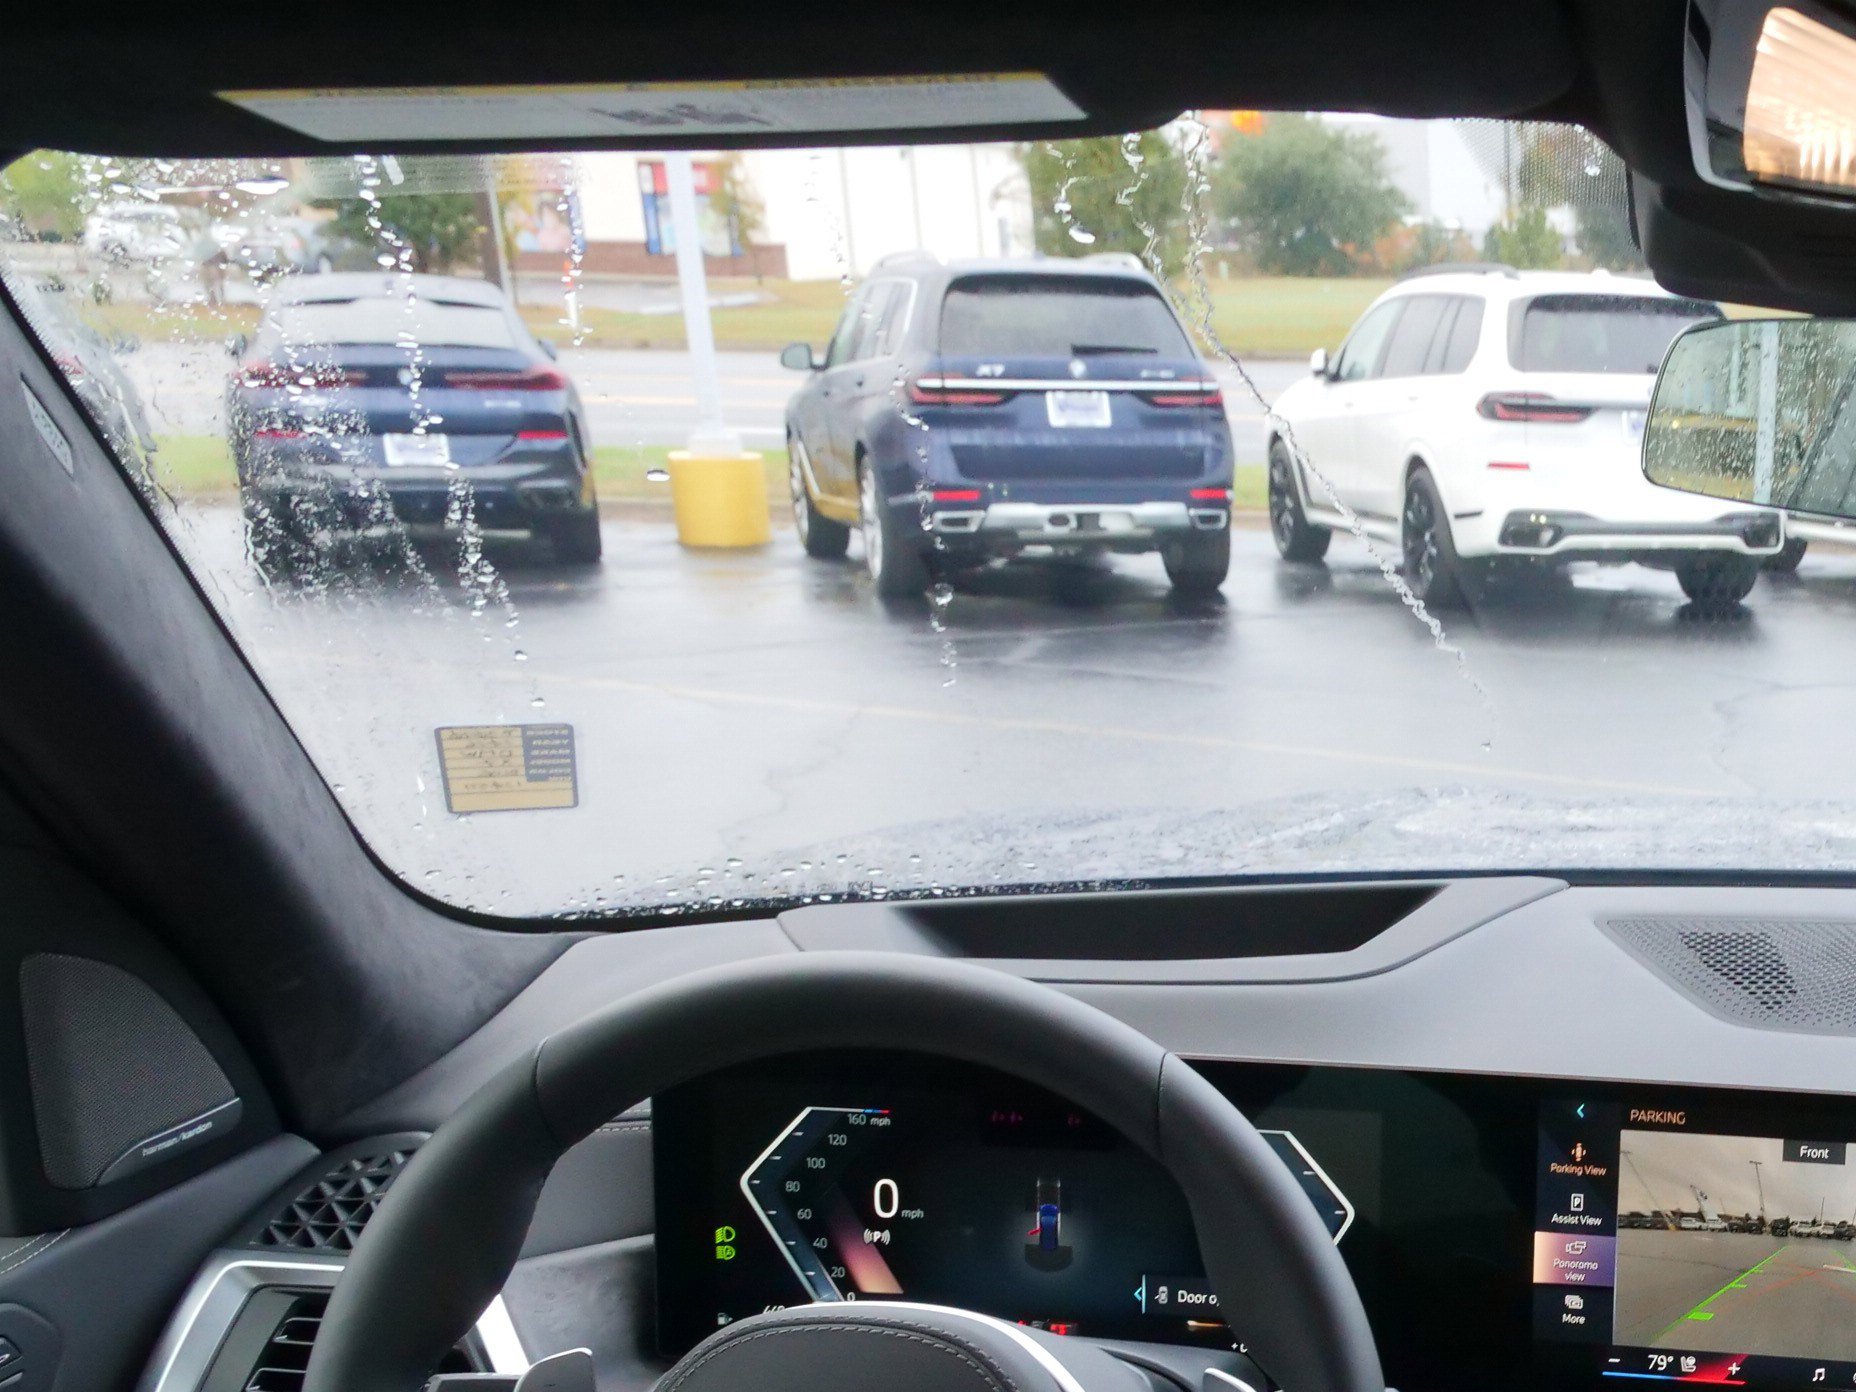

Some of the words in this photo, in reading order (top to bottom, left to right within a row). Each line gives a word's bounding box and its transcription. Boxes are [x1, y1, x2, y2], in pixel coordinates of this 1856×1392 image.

[848, 1113, 866, 1125] 160
[870, 1117, 890, 1126] mph
[1630, 1109, 1686, 1125] PARKING
[828, 1134, 847, 1146] 120
[1800, 1145, 1830, 1160] Front
[806, 1157, 826, 1169] 100
[1550, 1162, 1583, 1177] Parking
[1584, 1165, 1607, 1177] View
[785, 1180, 800, 1193] 80
[873, 1178, 899, 1219] 0
[901, 1209, 924, 1219] mph
[797, 1208, 812, 1220] 60
[1551, 1213, 1580, 1226] Assist
[1580, 1215, 1603, 1226] View
[813, 1237, 828, 1249] 40
[1553, 1258, 1599, 1271] Panorama
[831, 1266, 846, 1278] 20
[1564, 1271, 1586, 1282] view
[847, 1292, 856, 1302] 0
[1177, 1290, 1206, 1304] Door
[1562, 1313, 1586, 1325] More
